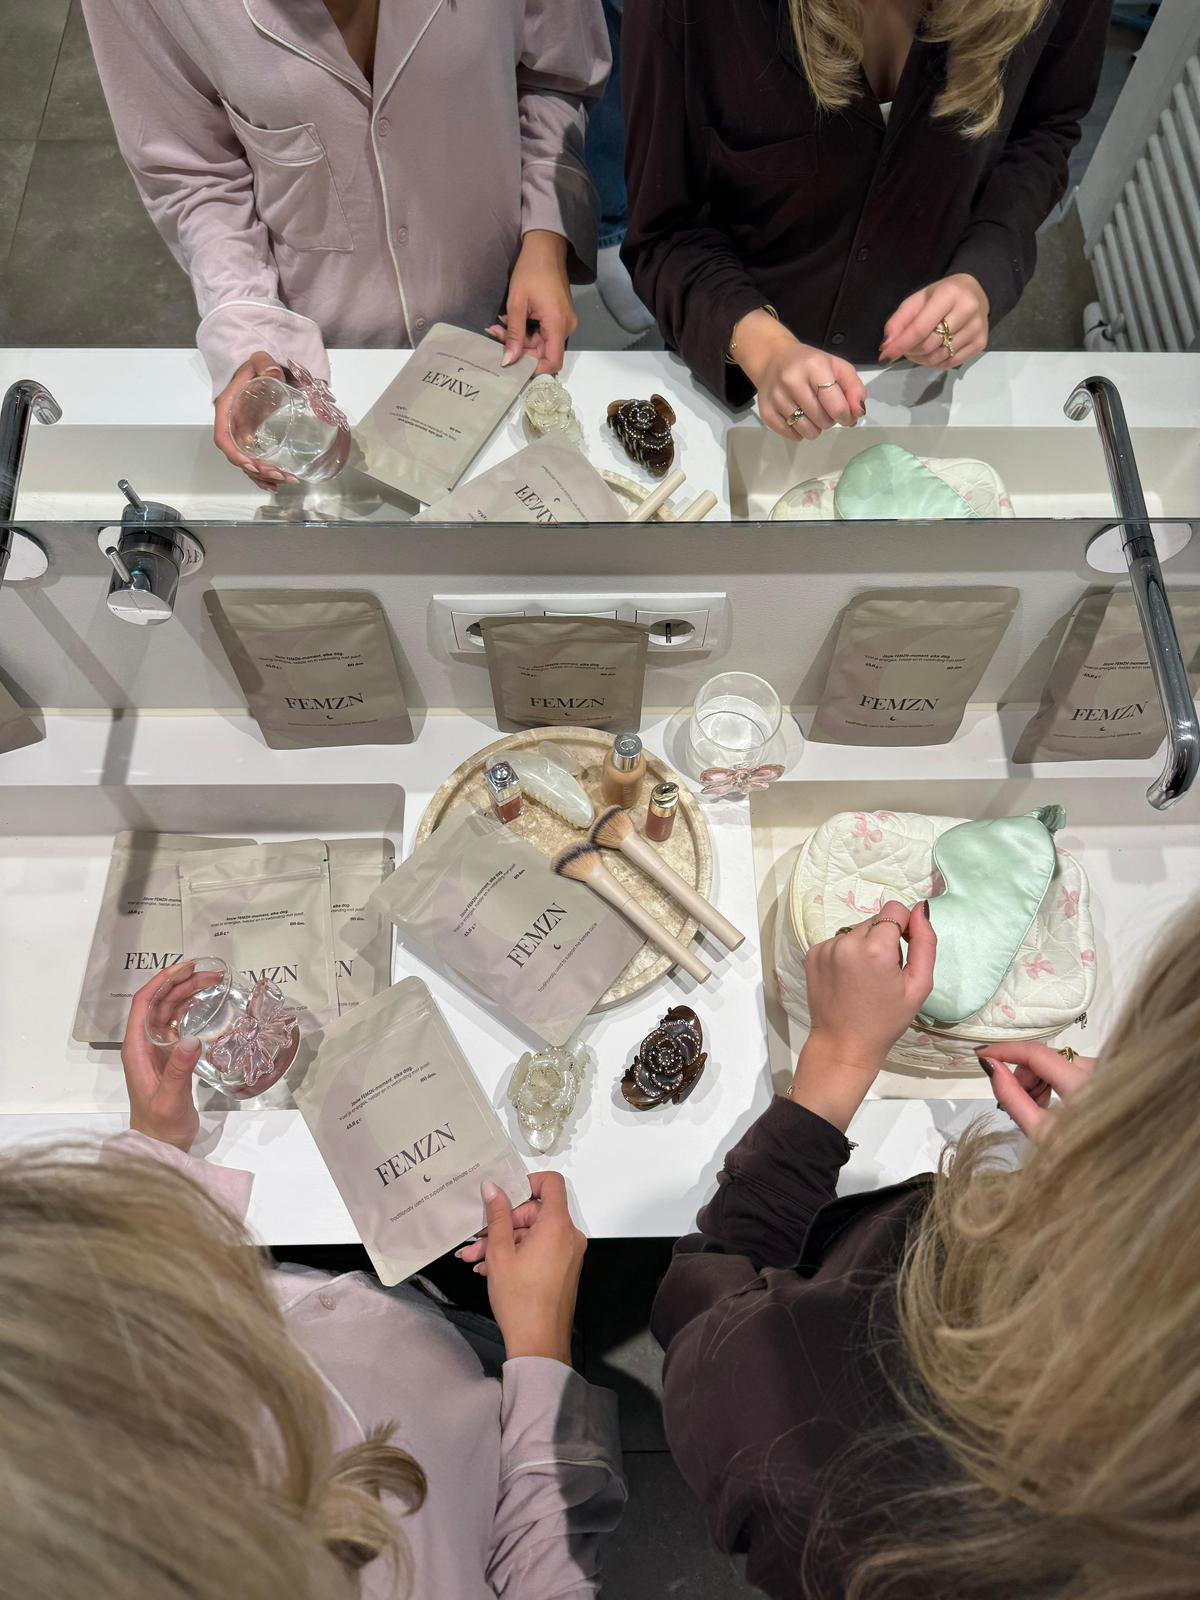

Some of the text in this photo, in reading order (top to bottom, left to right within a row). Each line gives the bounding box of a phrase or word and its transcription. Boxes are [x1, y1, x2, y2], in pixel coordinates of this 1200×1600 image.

[284, 692, 364, 710] FEMZN
[530, 697, 605, 708] FEMZN
[859, 695, 939, 711] FEMZN
[1070, 701, 1149, 720] FEMZN
[507, 902, 567, 968] FEMZN
[124, 953, 184, 969] FEMZ
[240, 964, 299, 984] MZN
[374, 1122, 456, 1187] FEMZN
